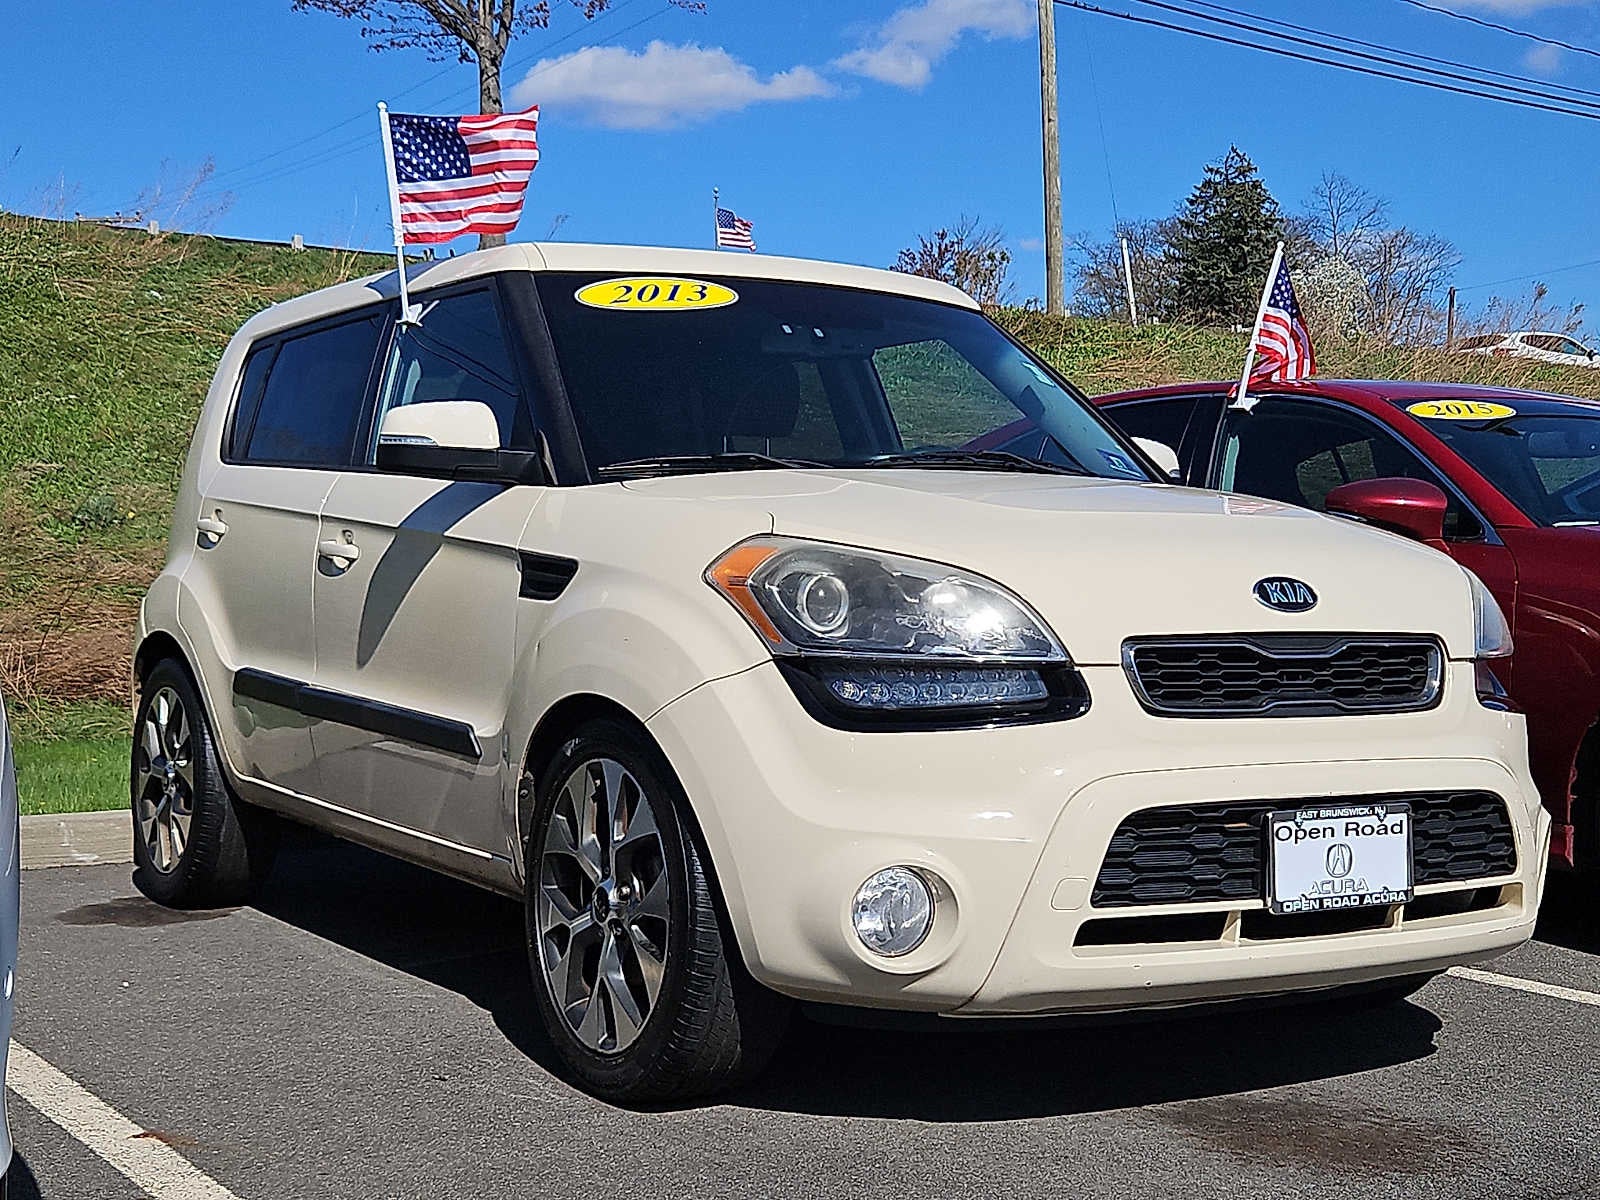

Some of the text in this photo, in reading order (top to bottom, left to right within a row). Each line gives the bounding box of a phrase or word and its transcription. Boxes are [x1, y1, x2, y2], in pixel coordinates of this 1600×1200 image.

[609, 284, 708, 305] 2013
[1427, 403, 1493, 416] 2015
[1263, 582, 1314, 603] KIA
[1296, 810, 1319, 819] EAST
[1275, 820, 1404, 844] Open Road
[1309, 878, 1370, 895] ACURA
[1282, 891, 1407, 913] OPEN ROAD ACURA
